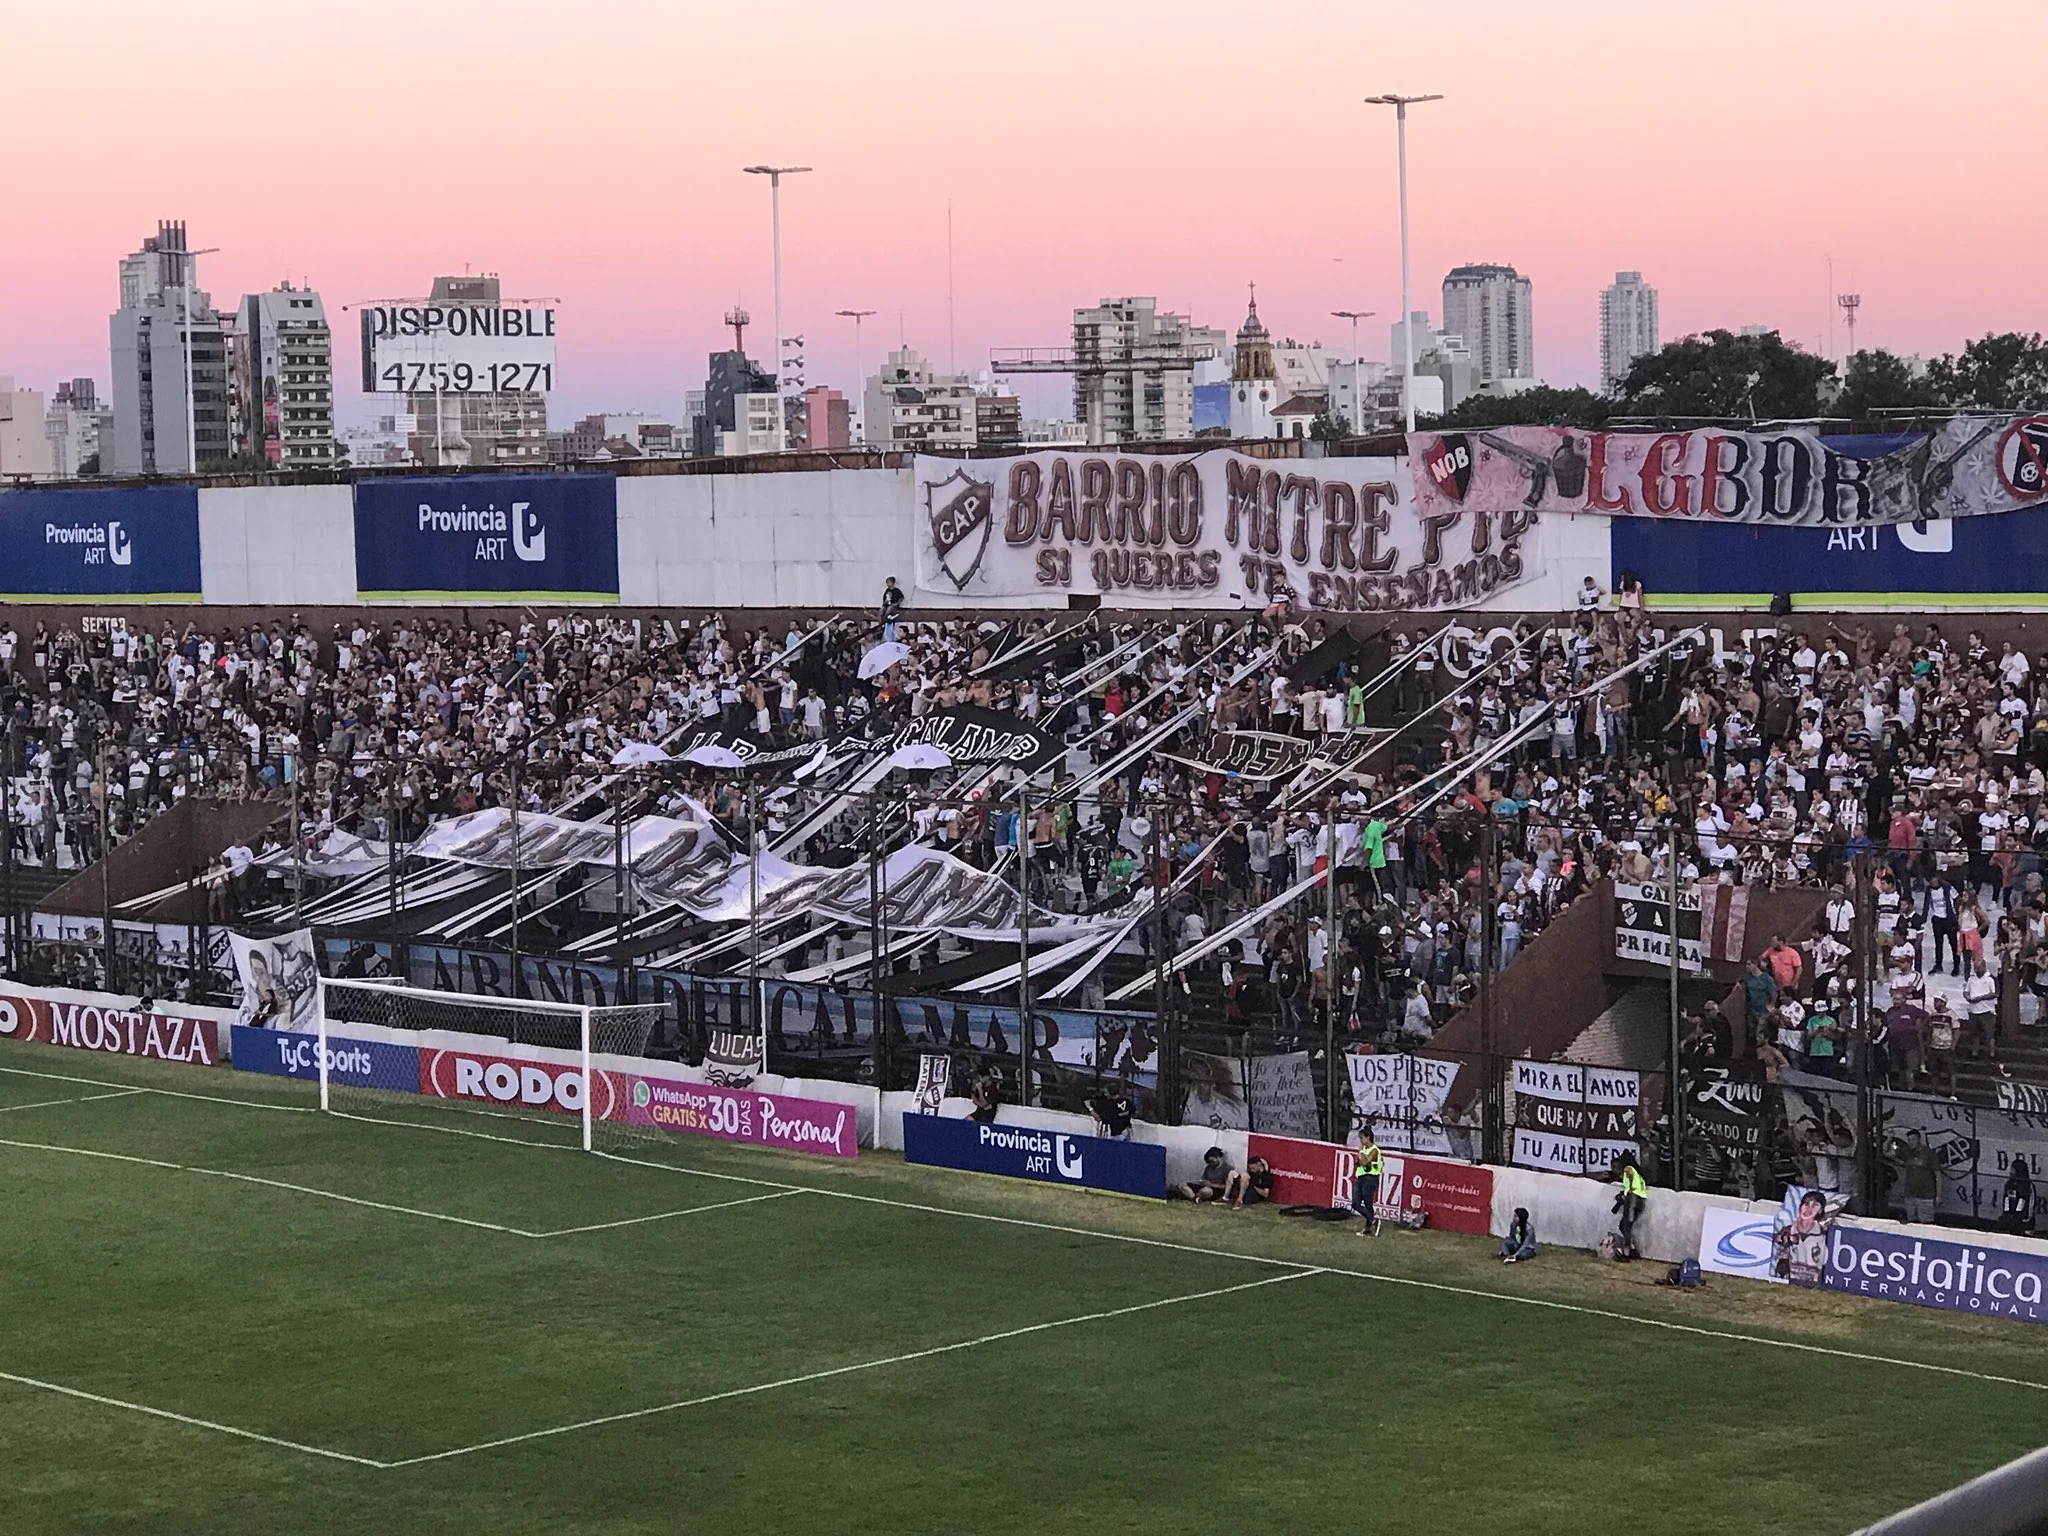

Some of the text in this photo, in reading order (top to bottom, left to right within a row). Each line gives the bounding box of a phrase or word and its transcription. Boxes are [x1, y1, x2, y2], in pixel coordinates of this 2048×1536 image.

[382, 362, 551, 392] 4759-1271
[1431, 446, 1469, 483] NOB
[418, 503, 507, 531] Provincia
[938, 494, 982, 545] CAP
[1004, 457, 1201, 546] BARRIO
[1225, 458, 1398, 573] MITRE
[46, 522, 105, 543] Provincia
[84, 548, 105, 564] ART
[475, 538, 507, 560] ART
[1036, 548, 1071, 584] SI
[1091, 548, 1221, 591] QUERES
[82, 616, 126, 633] SECTR
[50, 1003, 211, 1065] MOSTAZA
[709, 1029, 767, 1059] LUCAS
[277, 1038, 310, 1073] TyC
[455, 1058, 585, 1110] RODO
[1353, 1057, 1448, 1089] LOS PIBES
[1519, 1066, 1638, 1098] MIRA EL AMOR
[1375, 1085, 1427, 1103] DE LOS
[652, 1105, 696, 1128] GRATIS
[652, 1086, 846, 1154] WhatsApp 30 DÍAS Personal
[1537, 1104, 1564, 1127] QUE
[1606, 1113, 1619, 1132] A
[979, 1125, 1052, 1154] Provincia
[1521, 1137, 1636, 1166] TU ALREDED
[1938, 1136, 1970, 1167] AP
[1025, 1155, 1052, 1174] ART
[1336, 1151, 1401, 1207] RIZ
[1826, 1229, 2042, 1304] bestatica
[1826, 1275, 2038, 1318] NTERNACIONAL
